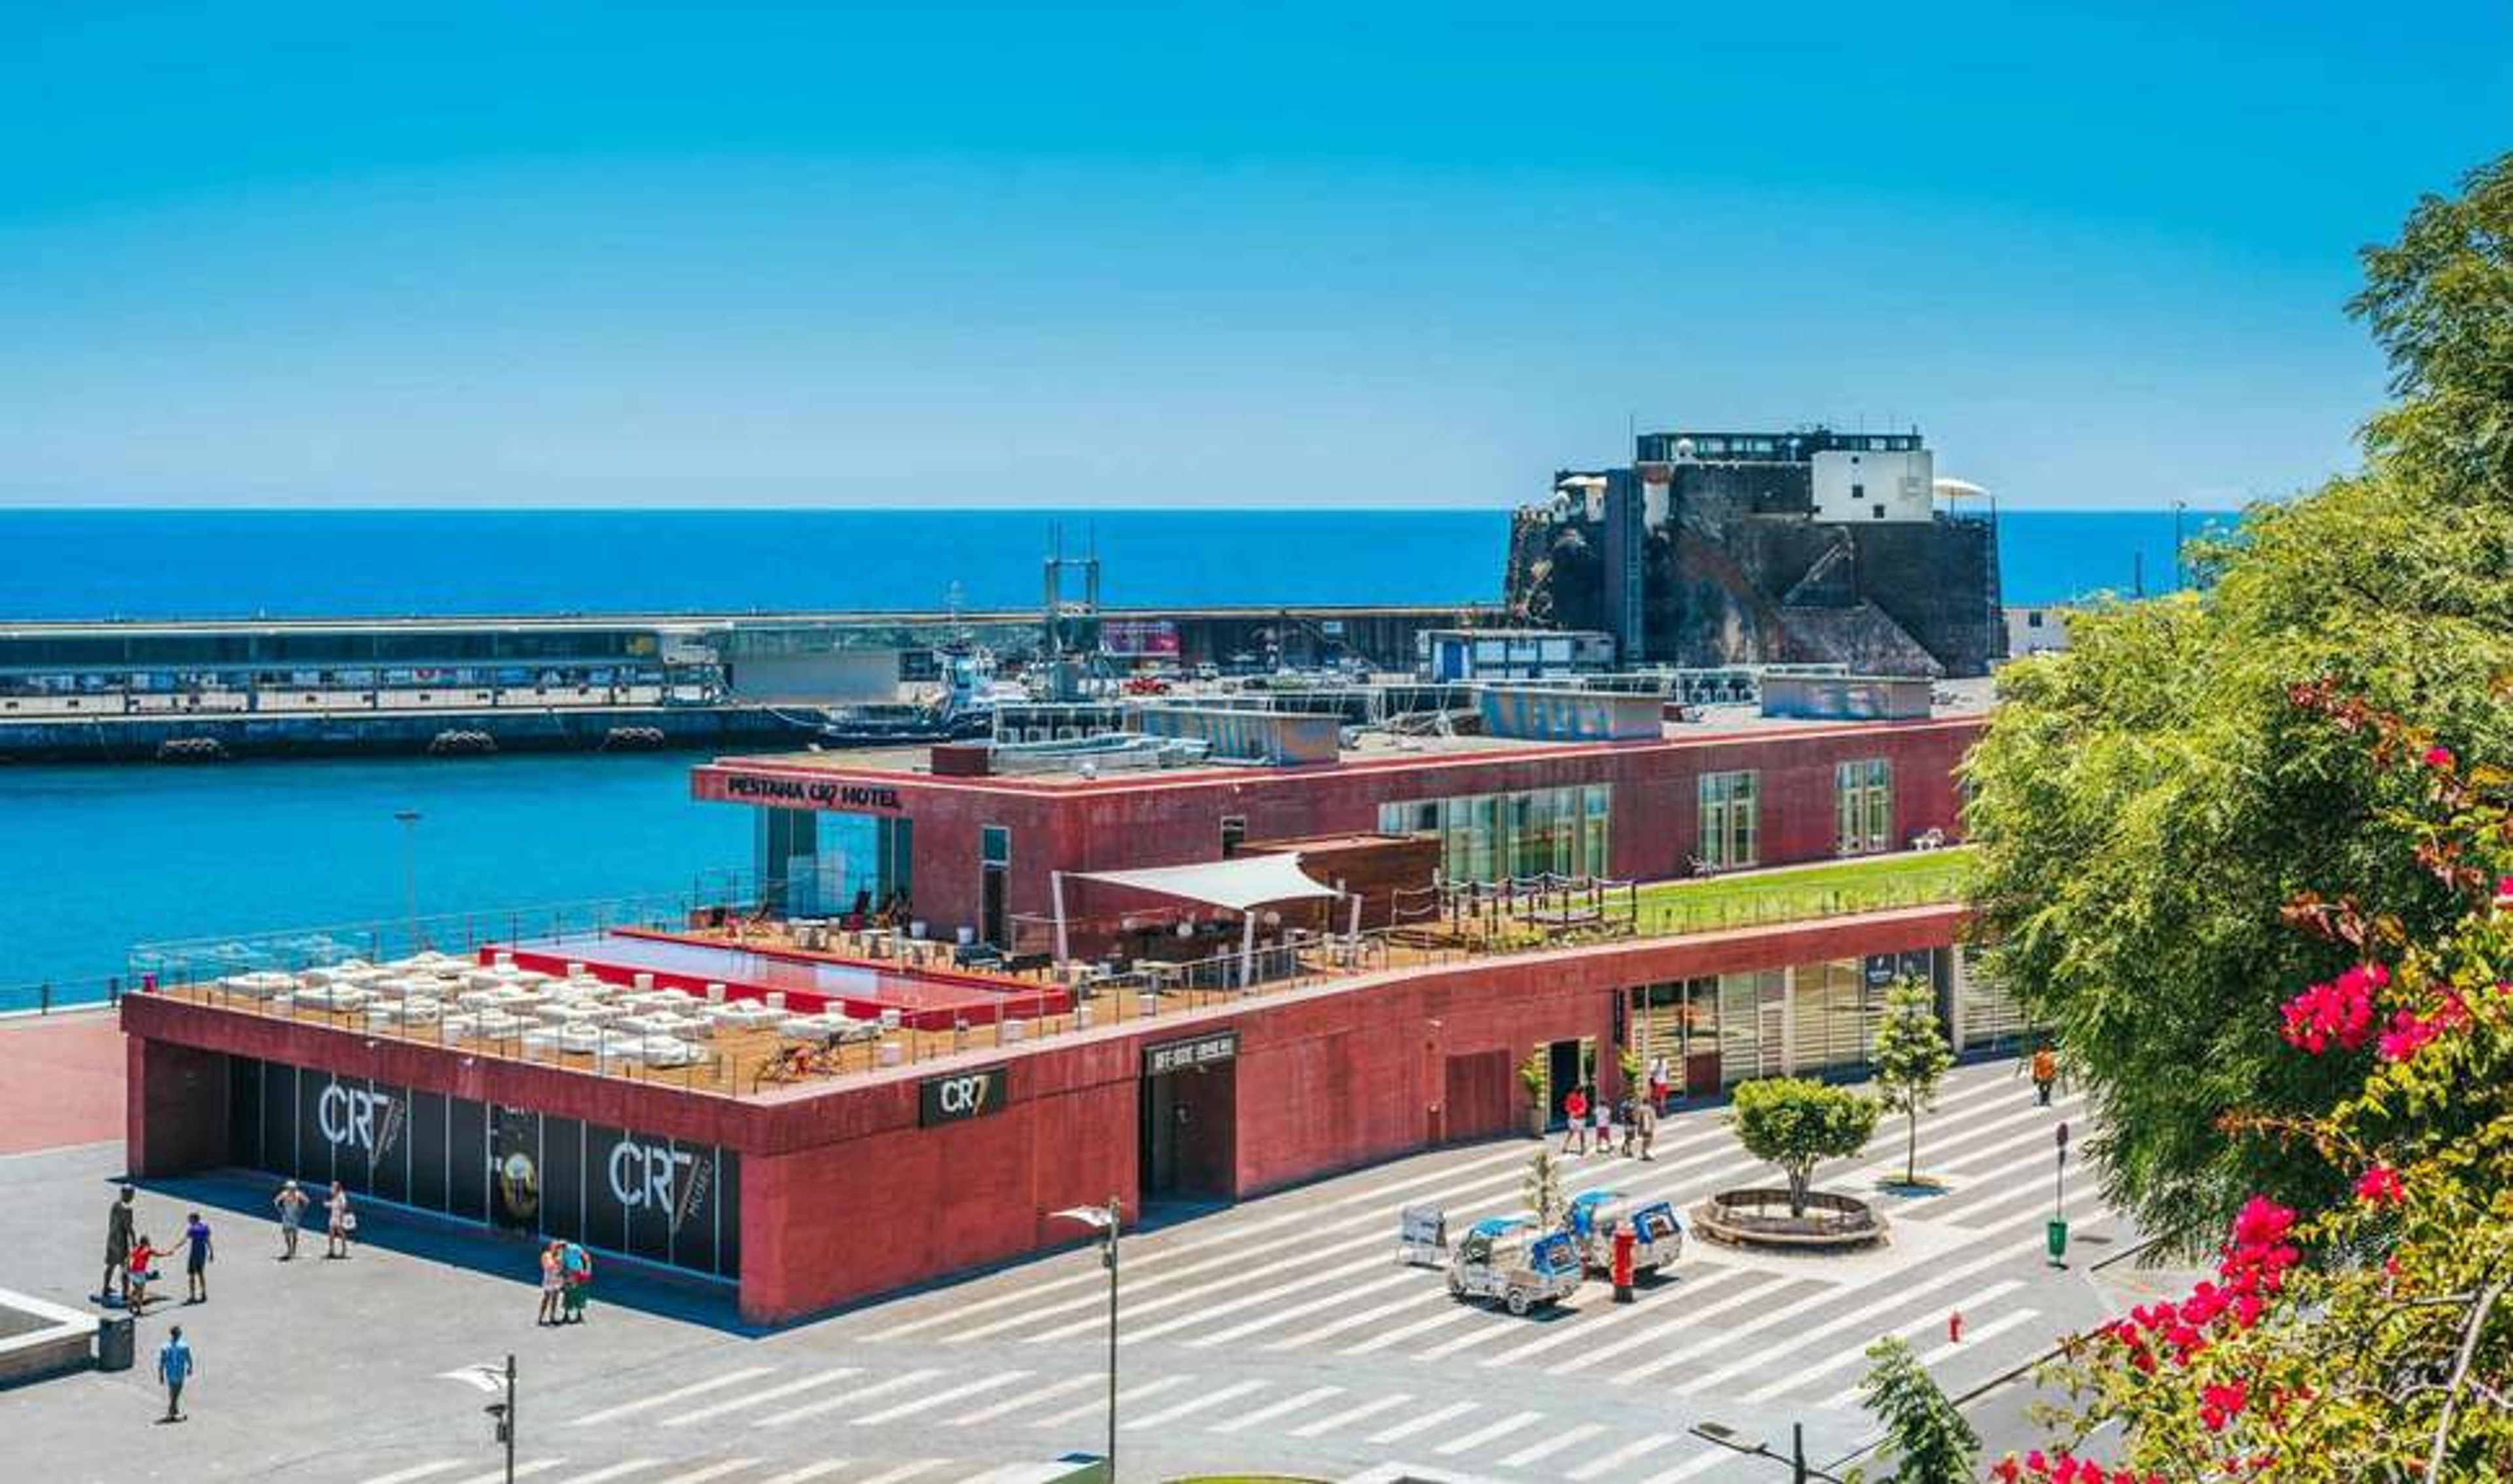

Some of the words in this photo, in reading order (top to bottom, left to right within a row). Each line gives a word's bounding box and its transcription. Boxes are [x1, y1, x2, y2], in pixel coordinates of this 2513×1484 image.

[727, 777, 805, 800] PESTANA
[809, 785, 836, 805] CR7
[842, 787, 903, 809] HOTEL
[319, 1084, 395, 1164] CR7
[940, 1076, 989, 1114] CR7
[609, 1142, 701, 1233] CR7
